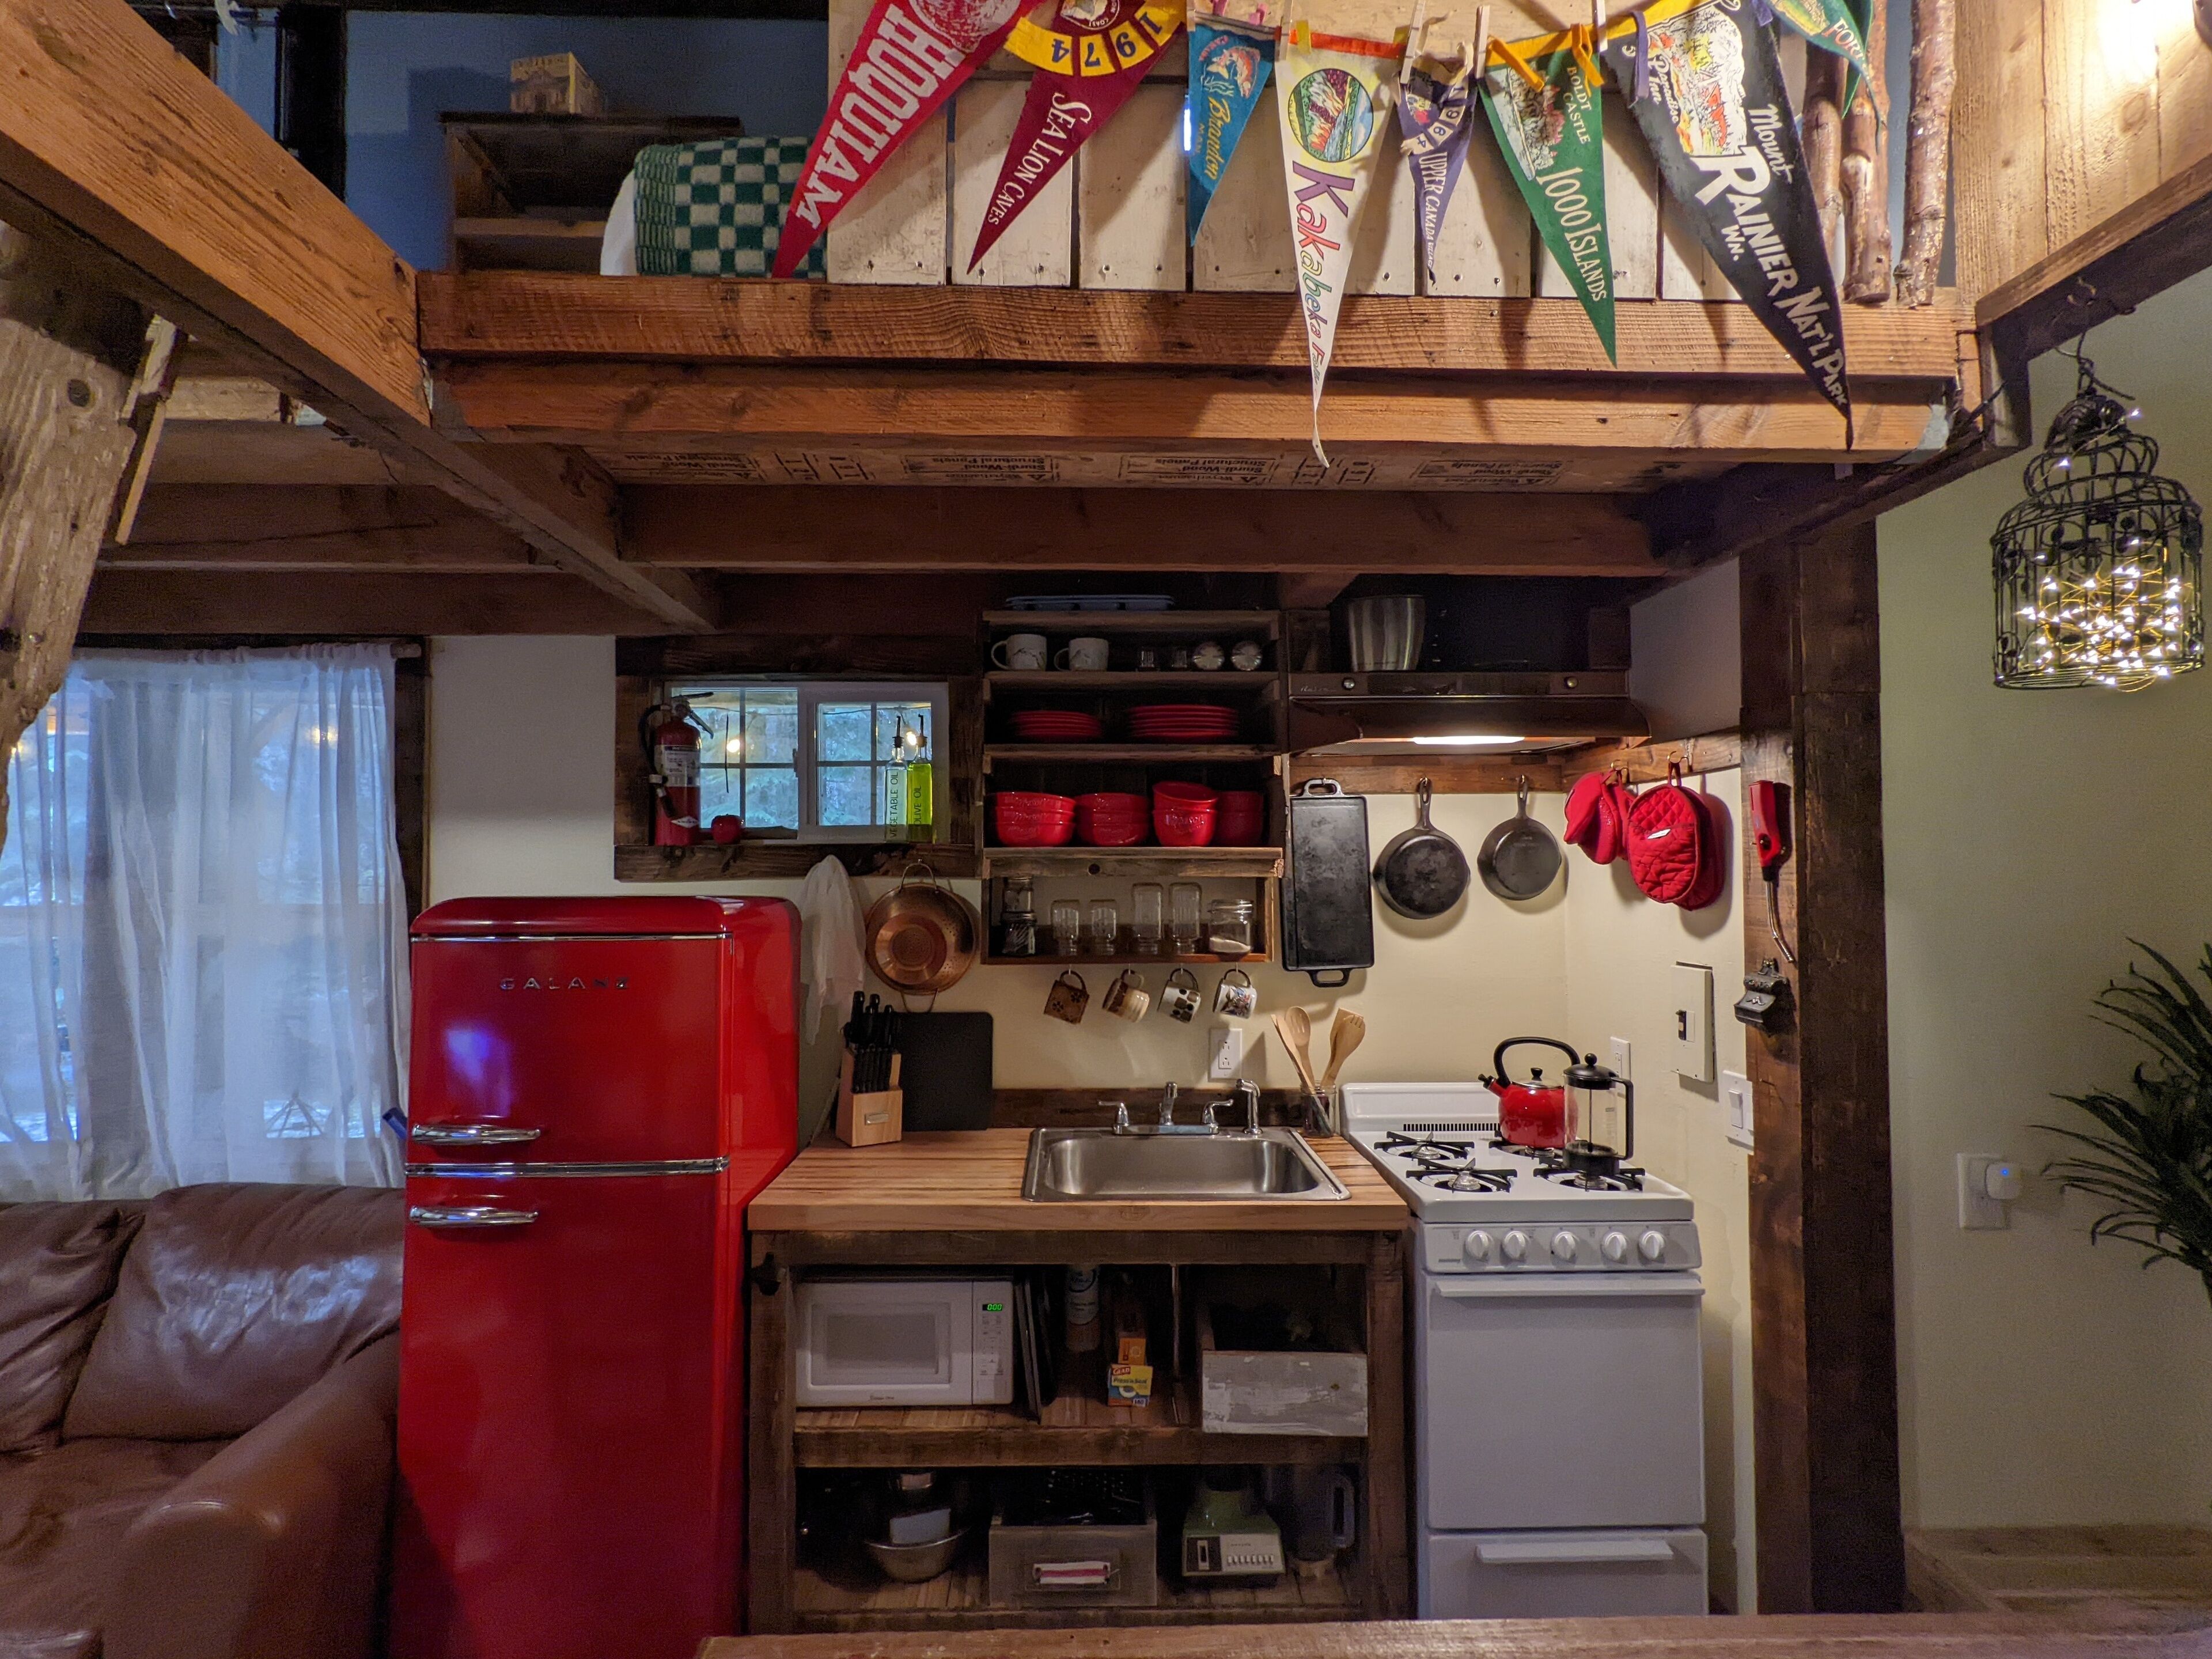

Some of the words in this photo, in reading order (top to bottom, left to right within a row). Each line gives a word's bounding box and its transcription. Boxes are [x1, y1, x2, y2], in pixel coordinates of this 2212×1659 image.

[1051, 11, 1163, 67] 1974
[1567, 67, 1592, 111] BOLDT
[1649, 55, 1679, 123] Paradise
[1649, 75, 1662, 105] Inn
[796, 3, 966, 230] HOQUIAM
[1041, 92, 1092, 140] SEA
[1205, 96, 1232, 180] Brandon
[1416, 86, 1465, 148] 1964
[1563, 92, 1591, 144] CASTLE
[1013, 138, 1065, 185] LION
[1747, 104, 1794, 184] Mount
[1418, 151, 1448, 195] UPPER
[988, 181, 1025, 225] CAVES
[1425, 195, 1441, 245] CANADA
[1292, 160, 1355, 339] Kakabeka
[1536, 167, 1592, 226] 1000
[1564, 223, 1607, 302] ISLANDS
[1691, 145, 1799, 297] RAINIER
[1774, 286, 1830, 361] NAT'L
[1812, 347, 1848, 406] PARK
[890, 772, 898, 785] OIL
[913, 785, 922, 798] OIL
[890, 789, 898, 838] VEGETABLE
[913, 803, 922, 827] OLIVE
[500, 978, 627, 990] GALANZ
